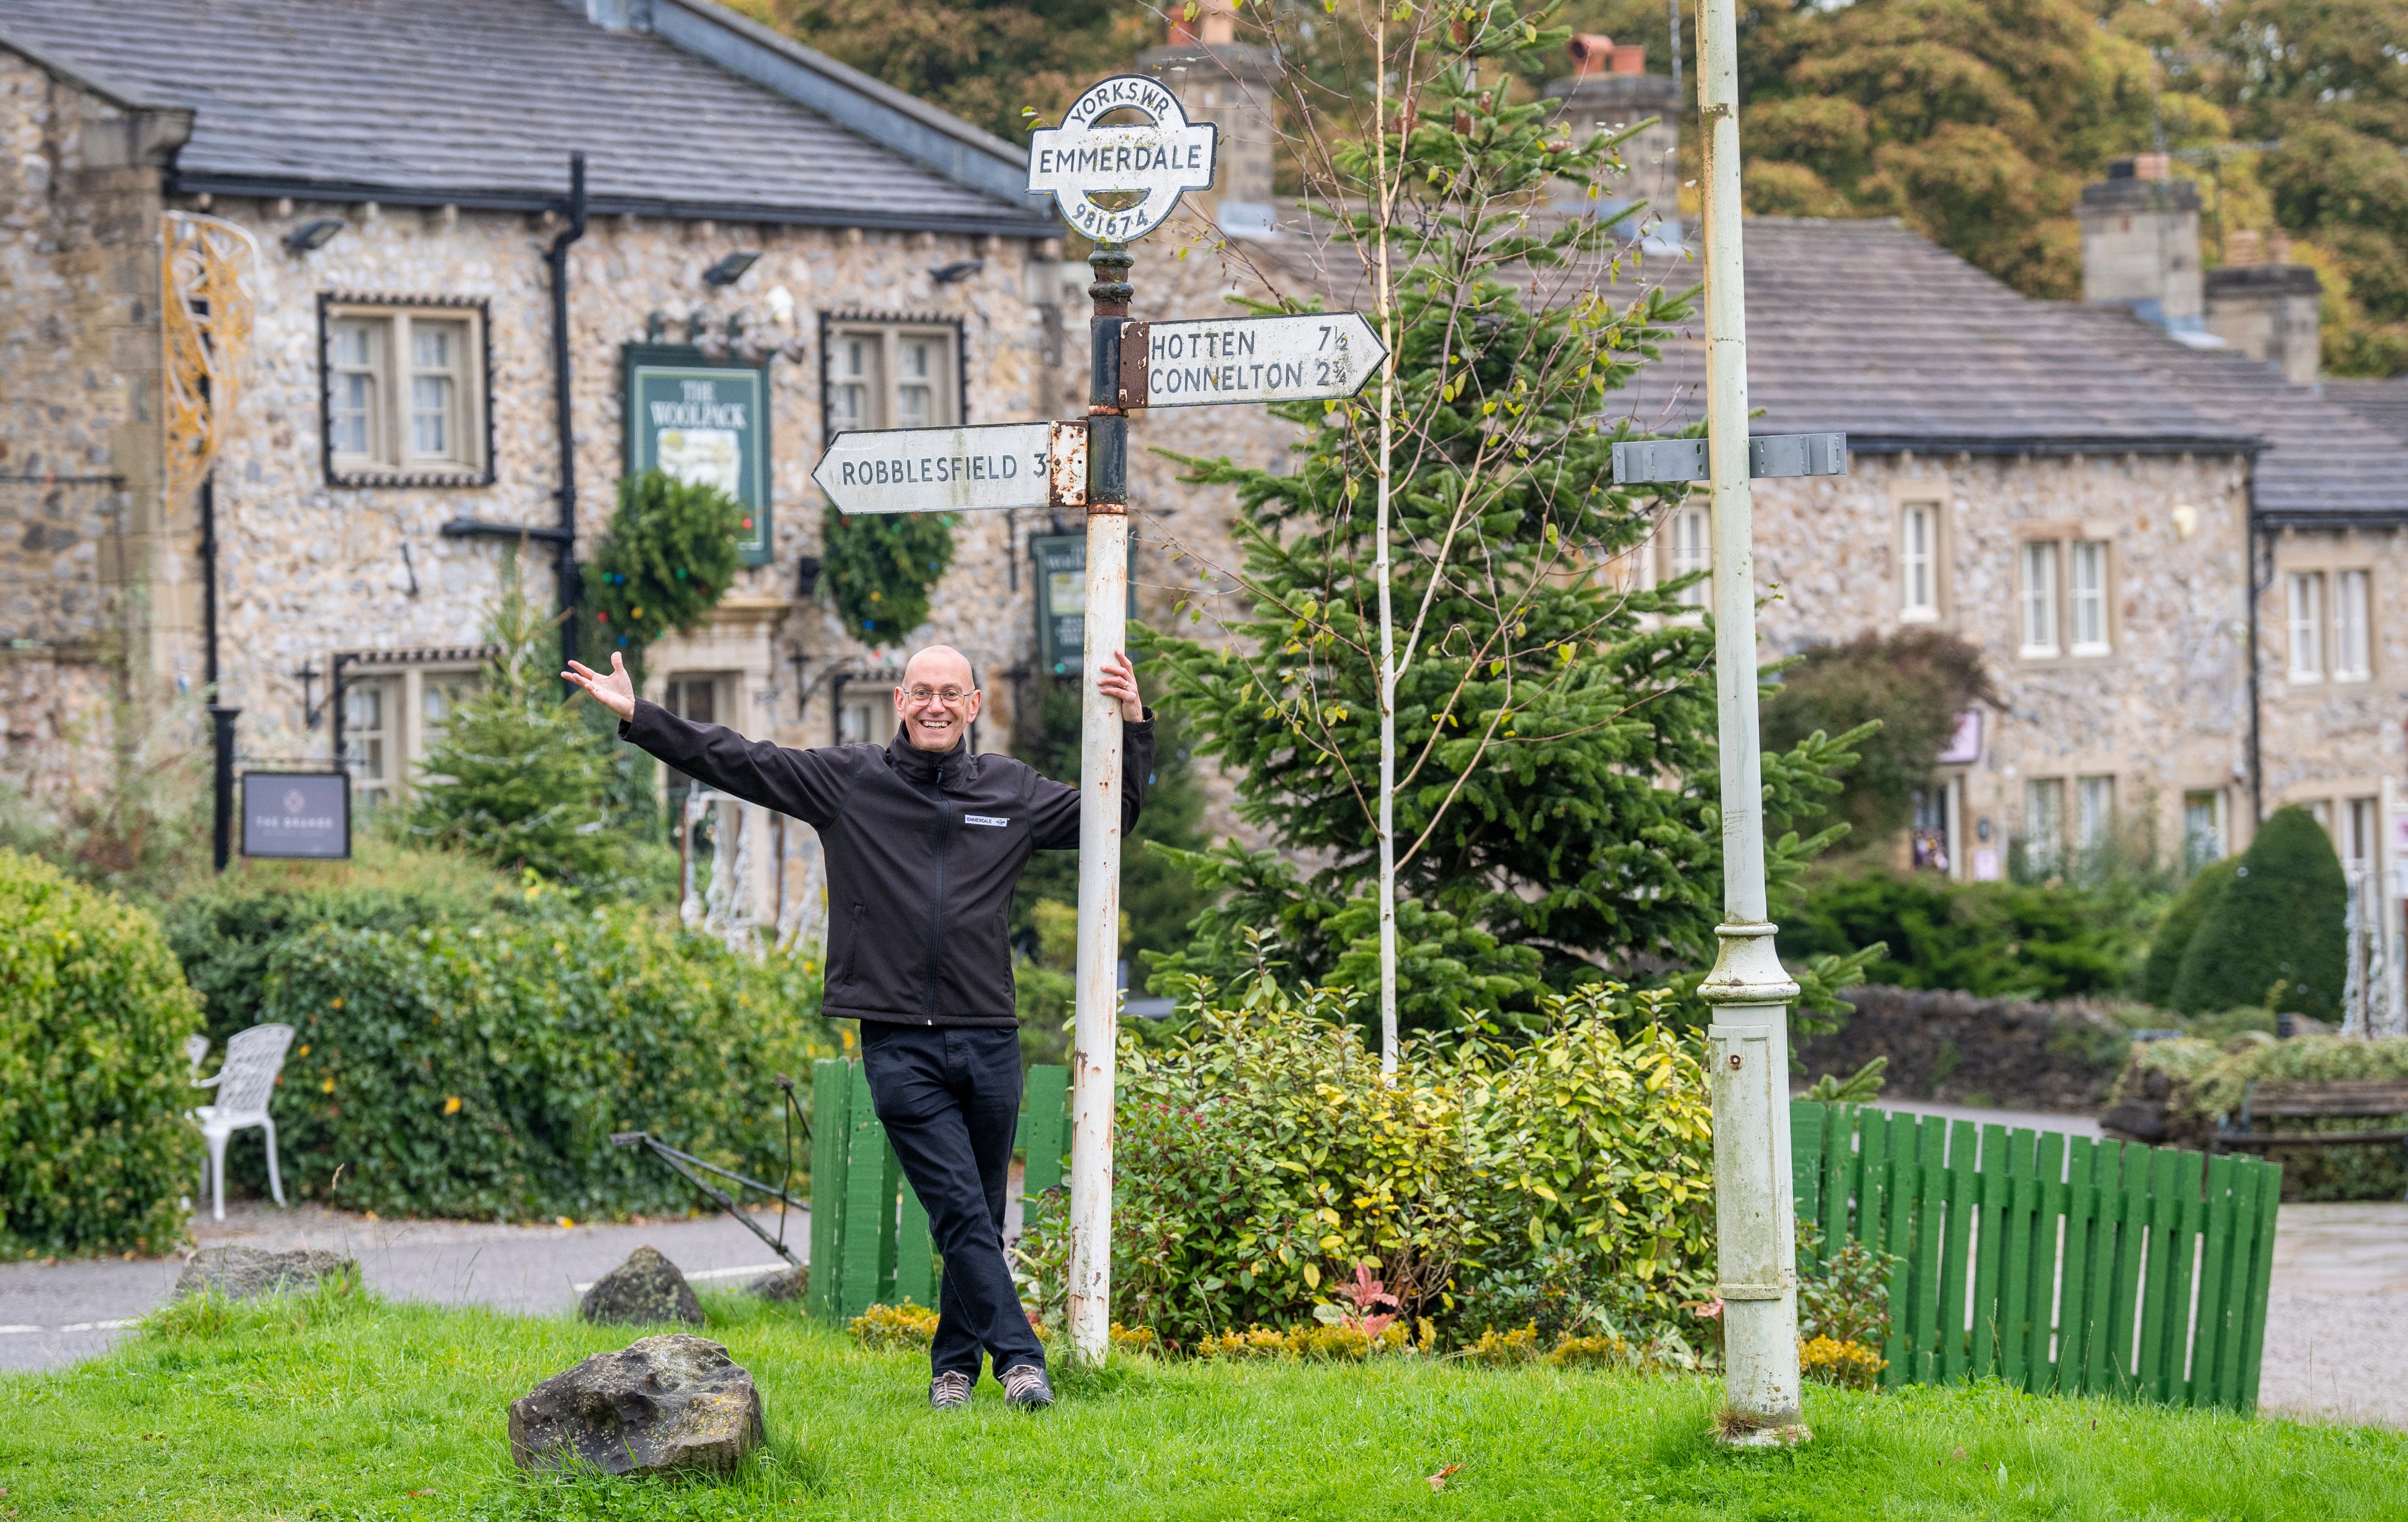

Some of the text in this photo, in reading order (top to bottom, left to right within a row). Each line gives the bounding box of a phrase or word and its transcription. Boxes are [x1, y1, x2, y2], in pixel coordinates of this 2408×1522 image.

[1040, 145, 1201, 173] EMMERDALE
[1073, 203, 1148, 235] 981674
[1152, 330, 1255, 360] HOTTEN
[680, 380, 717, 401] THE
[1151, 362, 1302, 394] CONNELTON
[650, 401, 747, 429] WOOLPACK
[842, 453, 1047, 485] ROBBLESFIELD 3
